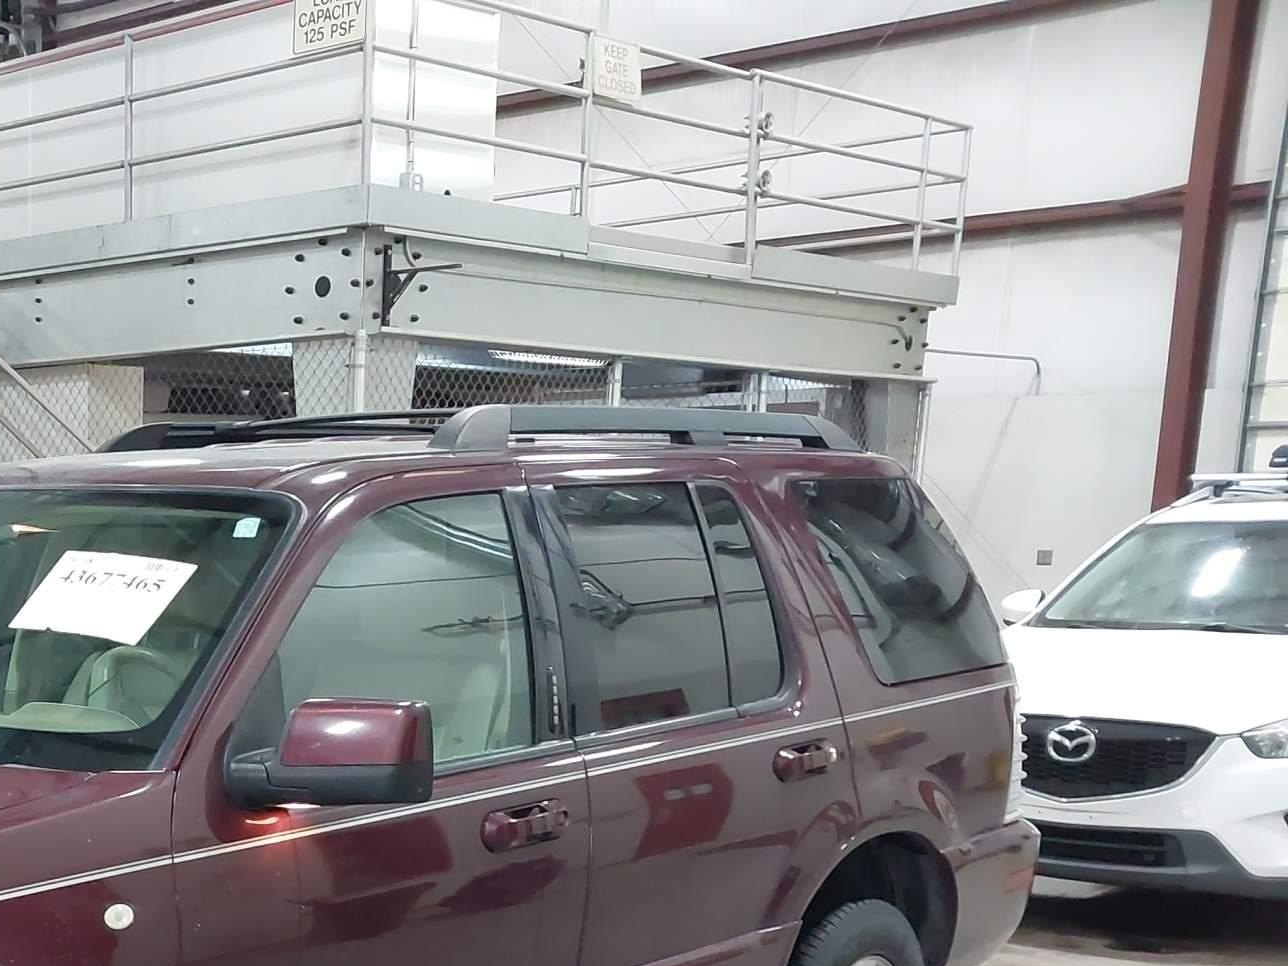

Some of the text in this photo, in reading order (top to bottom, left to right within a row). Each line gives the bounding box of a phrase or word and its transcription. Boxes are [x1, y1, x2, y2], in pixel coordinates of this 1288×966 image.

[298, 0, 362, 28] CAPACITY
[304, 18, 356, 44] 125 PSF
[604, 43, 629, 60] KEEP
[605, 60, 629, 78] GATE
[599, 74, 636, 95] CLOSED
